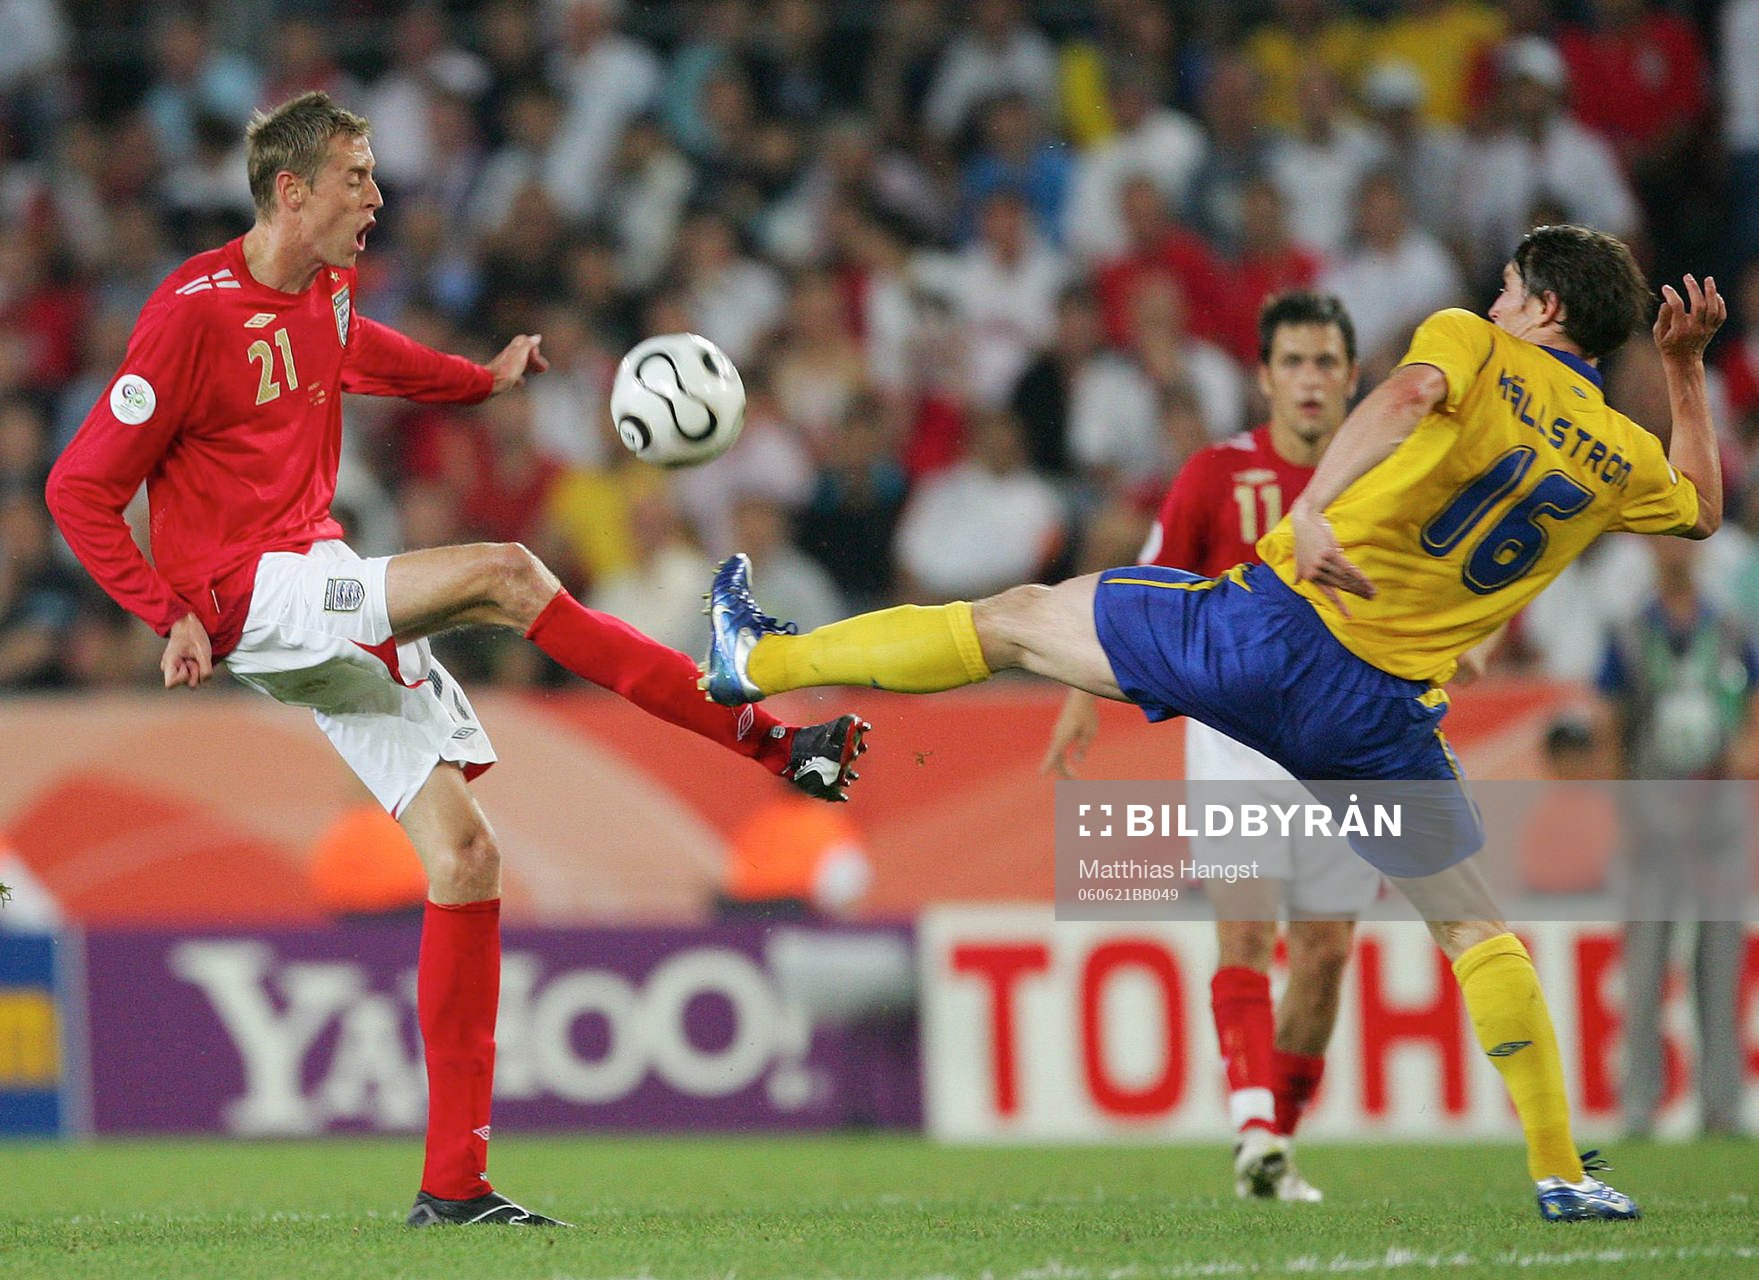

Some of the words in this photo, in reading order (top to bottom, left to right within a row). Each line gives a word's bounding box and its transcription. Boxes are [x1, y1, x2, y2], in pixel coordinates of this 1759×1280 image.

[247, 327, 299, 406] 21
[1233, 485, 1283, 544] 11
[1420, 444, 1596, 595] 16
